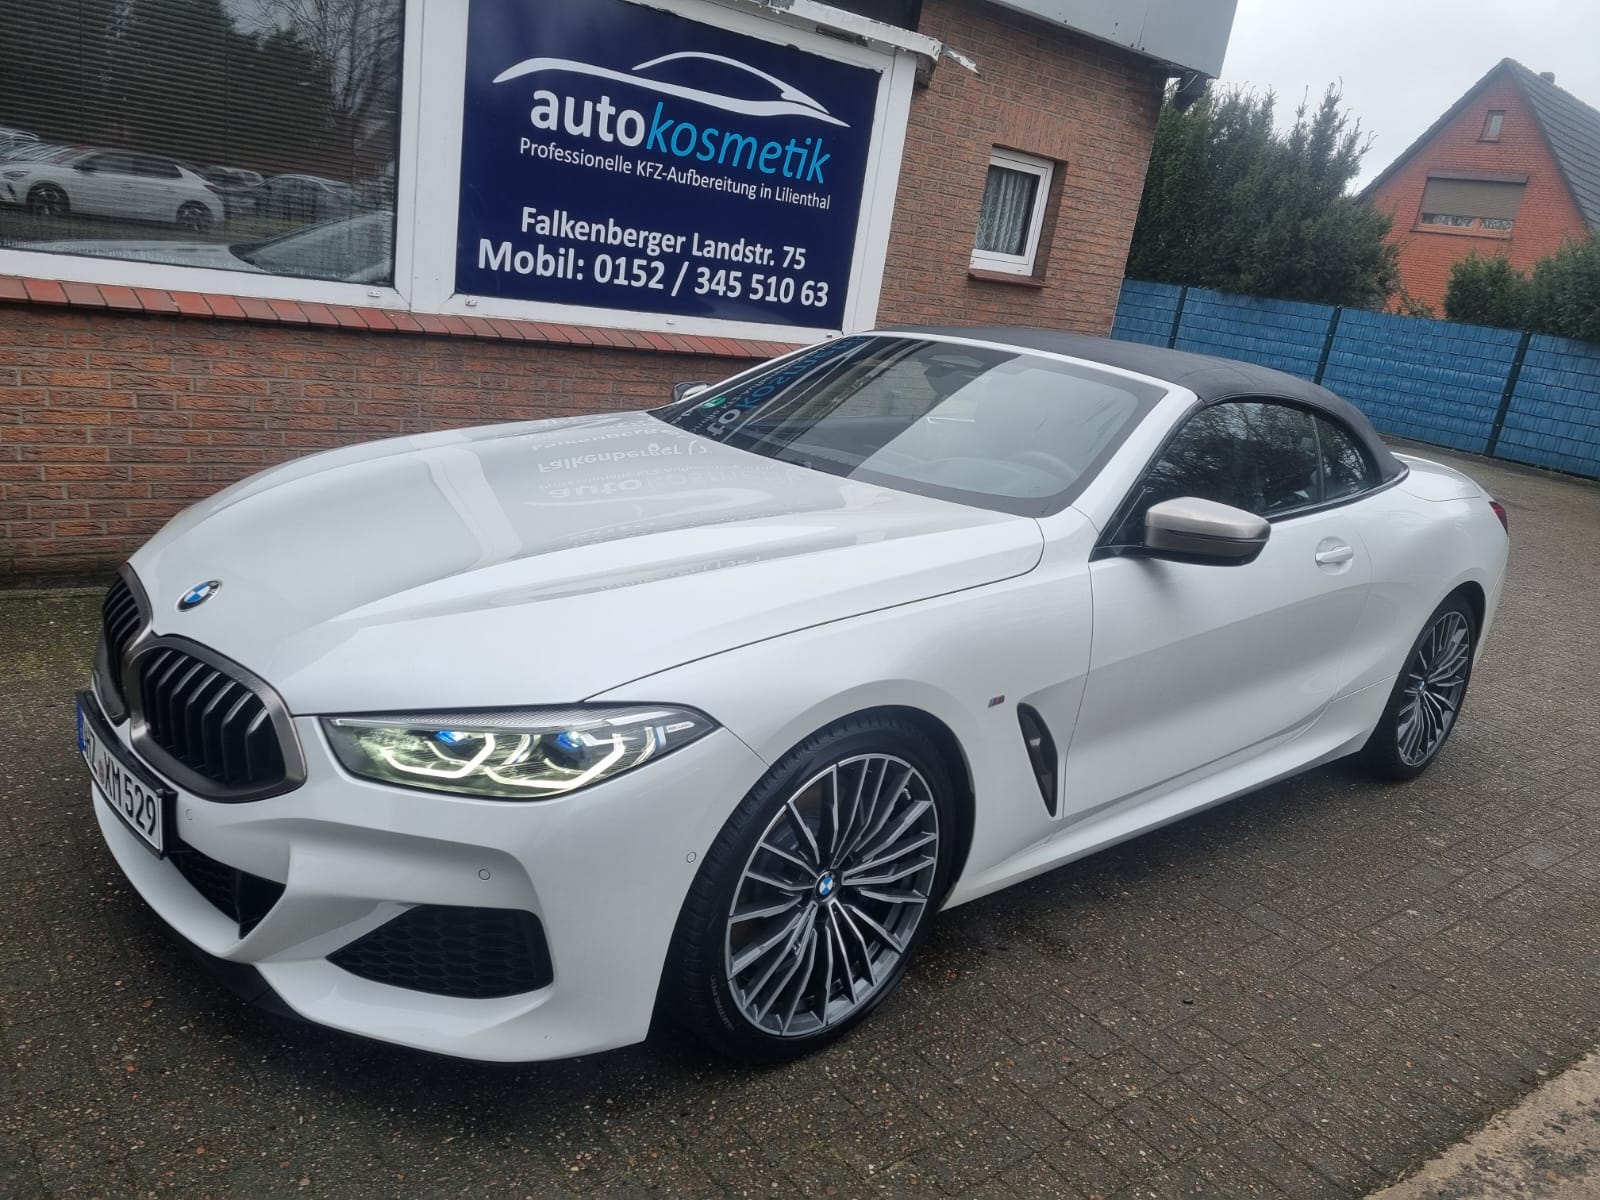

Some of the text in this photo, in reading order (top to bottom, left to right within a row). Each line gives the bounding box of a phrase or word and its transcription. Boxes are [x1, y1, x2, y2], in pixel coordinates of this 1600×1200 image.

[530, 90, 831, 184] autokosmetik
[520, 137, 831, 210] Professionelle KFZ-Aufbereitung in Lilienthal
[478, 238, 829, 307] Mobil: 0152 / 345 510 63
[521, 206, 806, 270] Falkenberger Landstr. 75
[123, 773, 157, 837] 529
